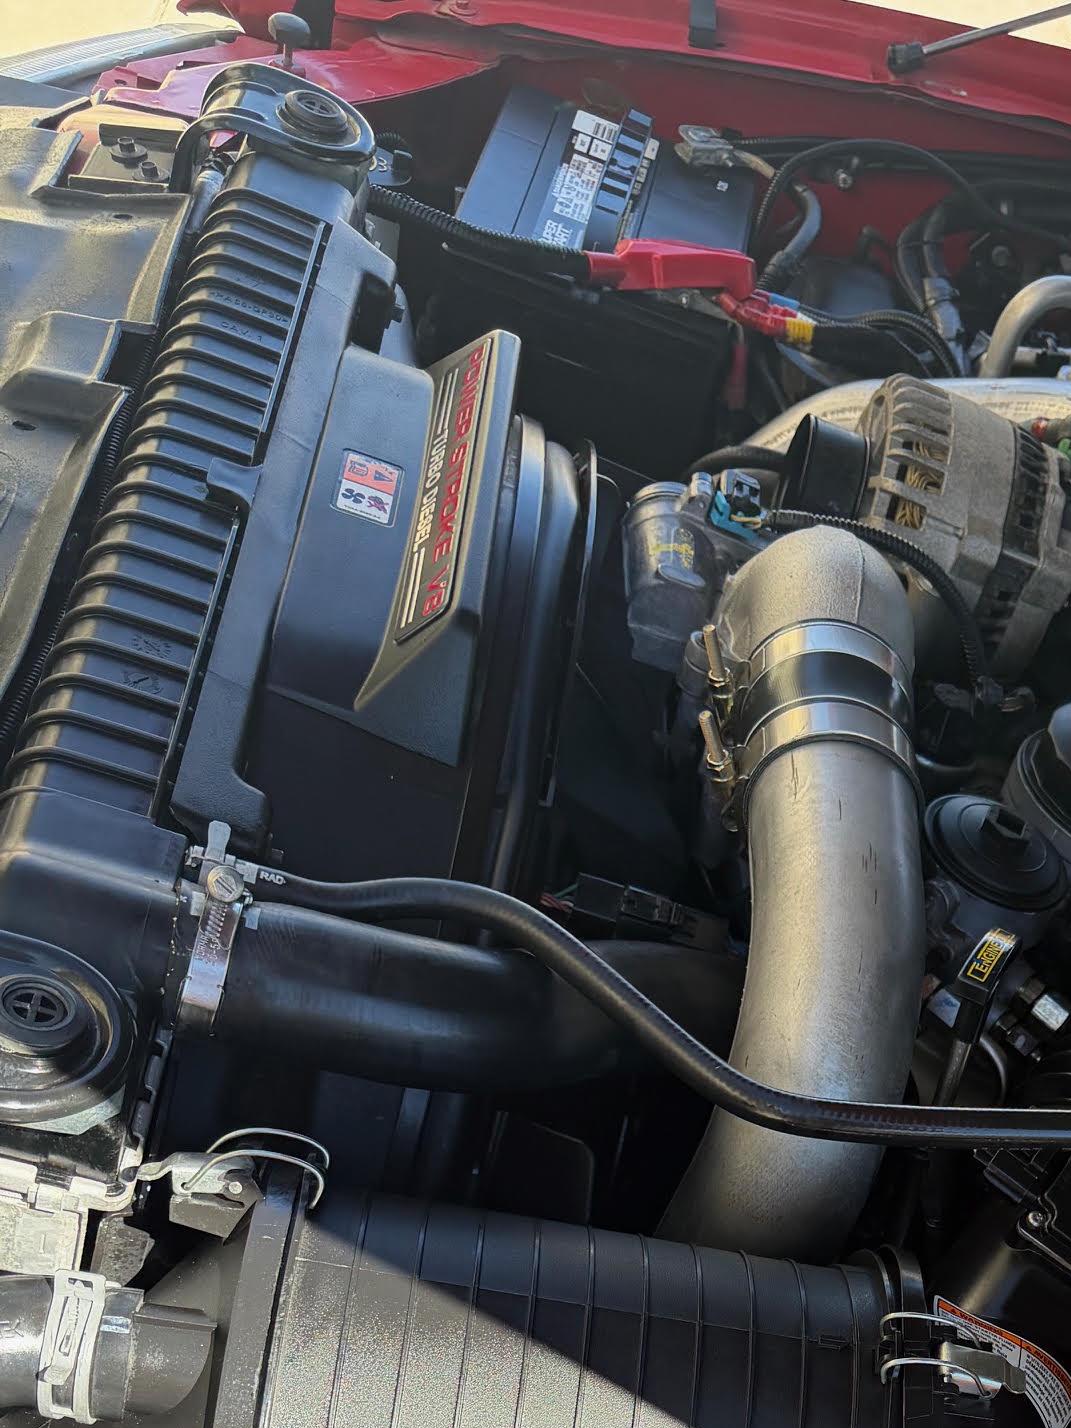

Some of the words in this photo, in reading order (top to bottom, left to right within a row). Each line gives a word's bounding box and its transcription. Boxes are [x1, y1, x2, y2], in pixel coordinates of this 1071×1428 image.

[456, 345, 486, 440] POWER
[425, 429, 449, 488] TURBO
[413, 487, 438, 553] DIESEL
[432, 441, 470, 563] STROKE
[422, 564, 450, 616] V8
